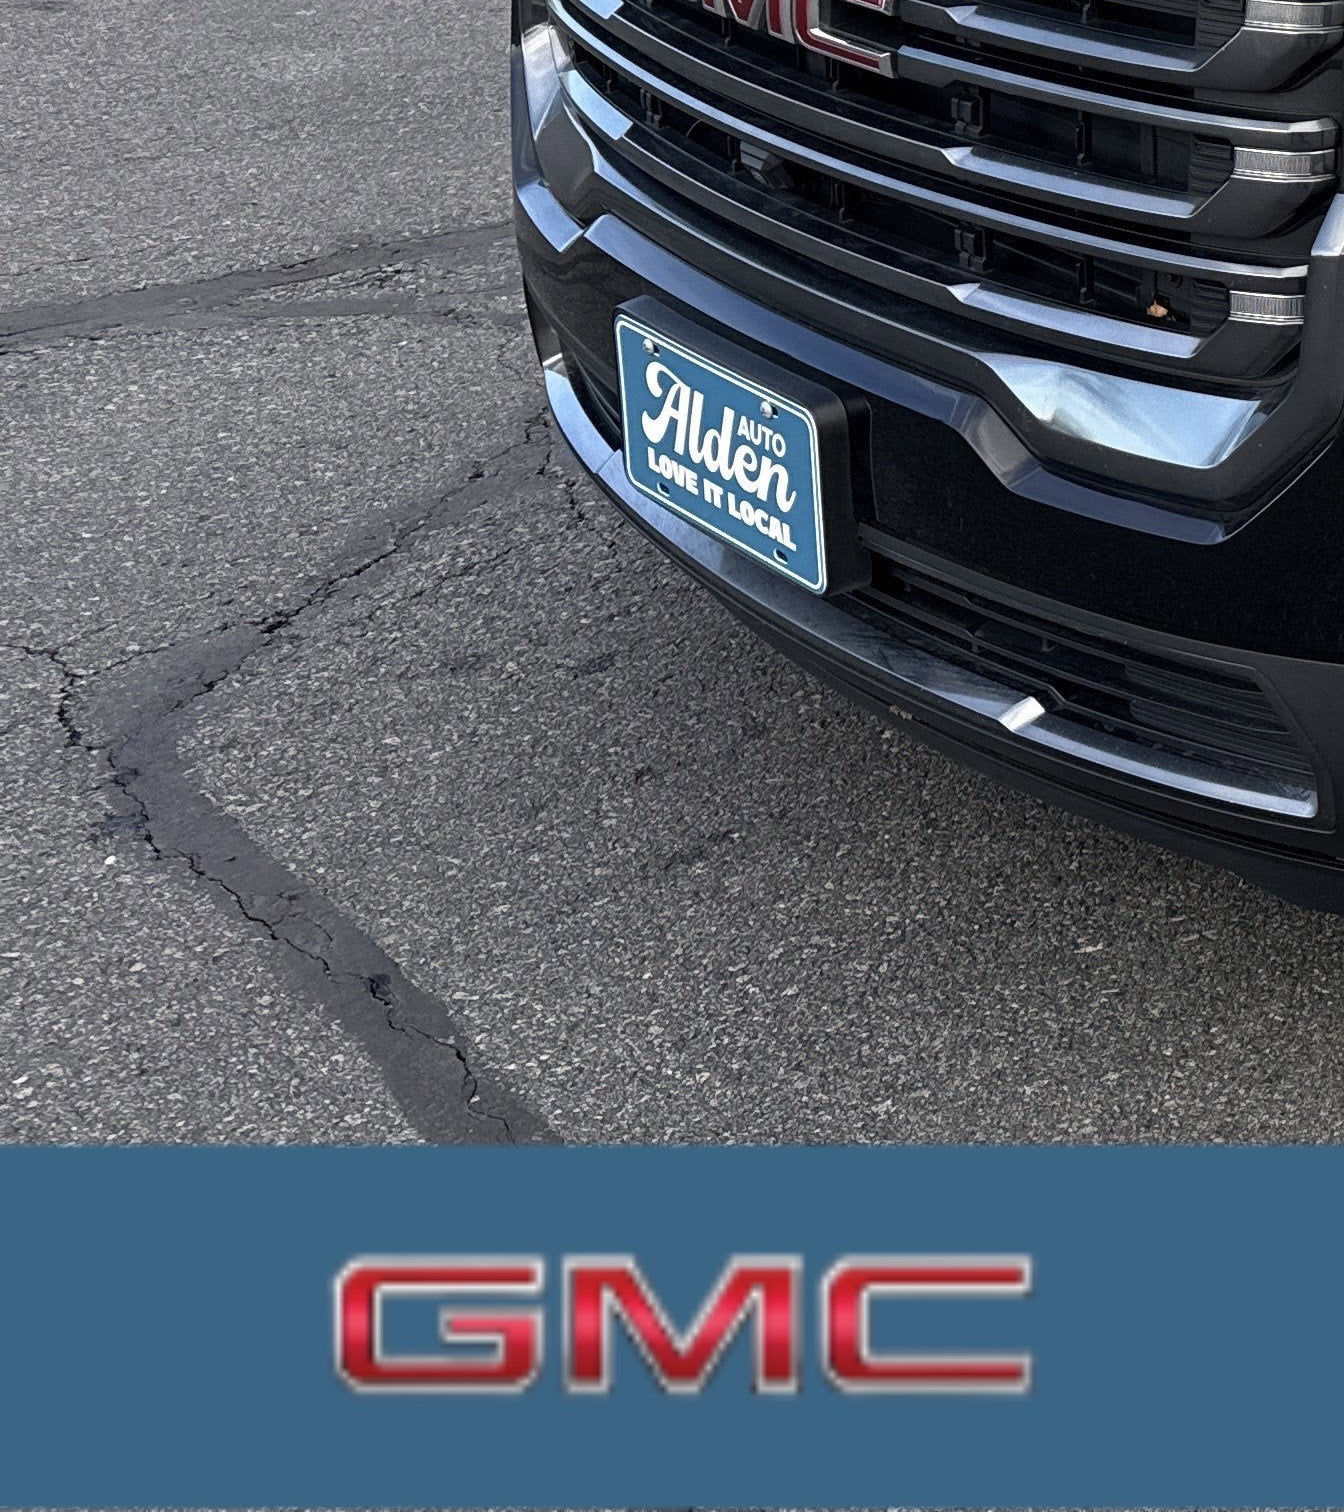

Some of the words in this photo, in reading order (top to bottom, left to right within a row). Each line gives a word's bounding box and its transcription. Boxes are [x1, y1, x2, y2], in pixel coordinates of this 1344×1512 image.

[641, 361, 797, 513] Alden
[736, 415, 787, 458] AUTO
[647, 447, 699, 496] LOVE
[703, 478, 724, 507] IT
[727, 492, 797, 552] LOCAL
